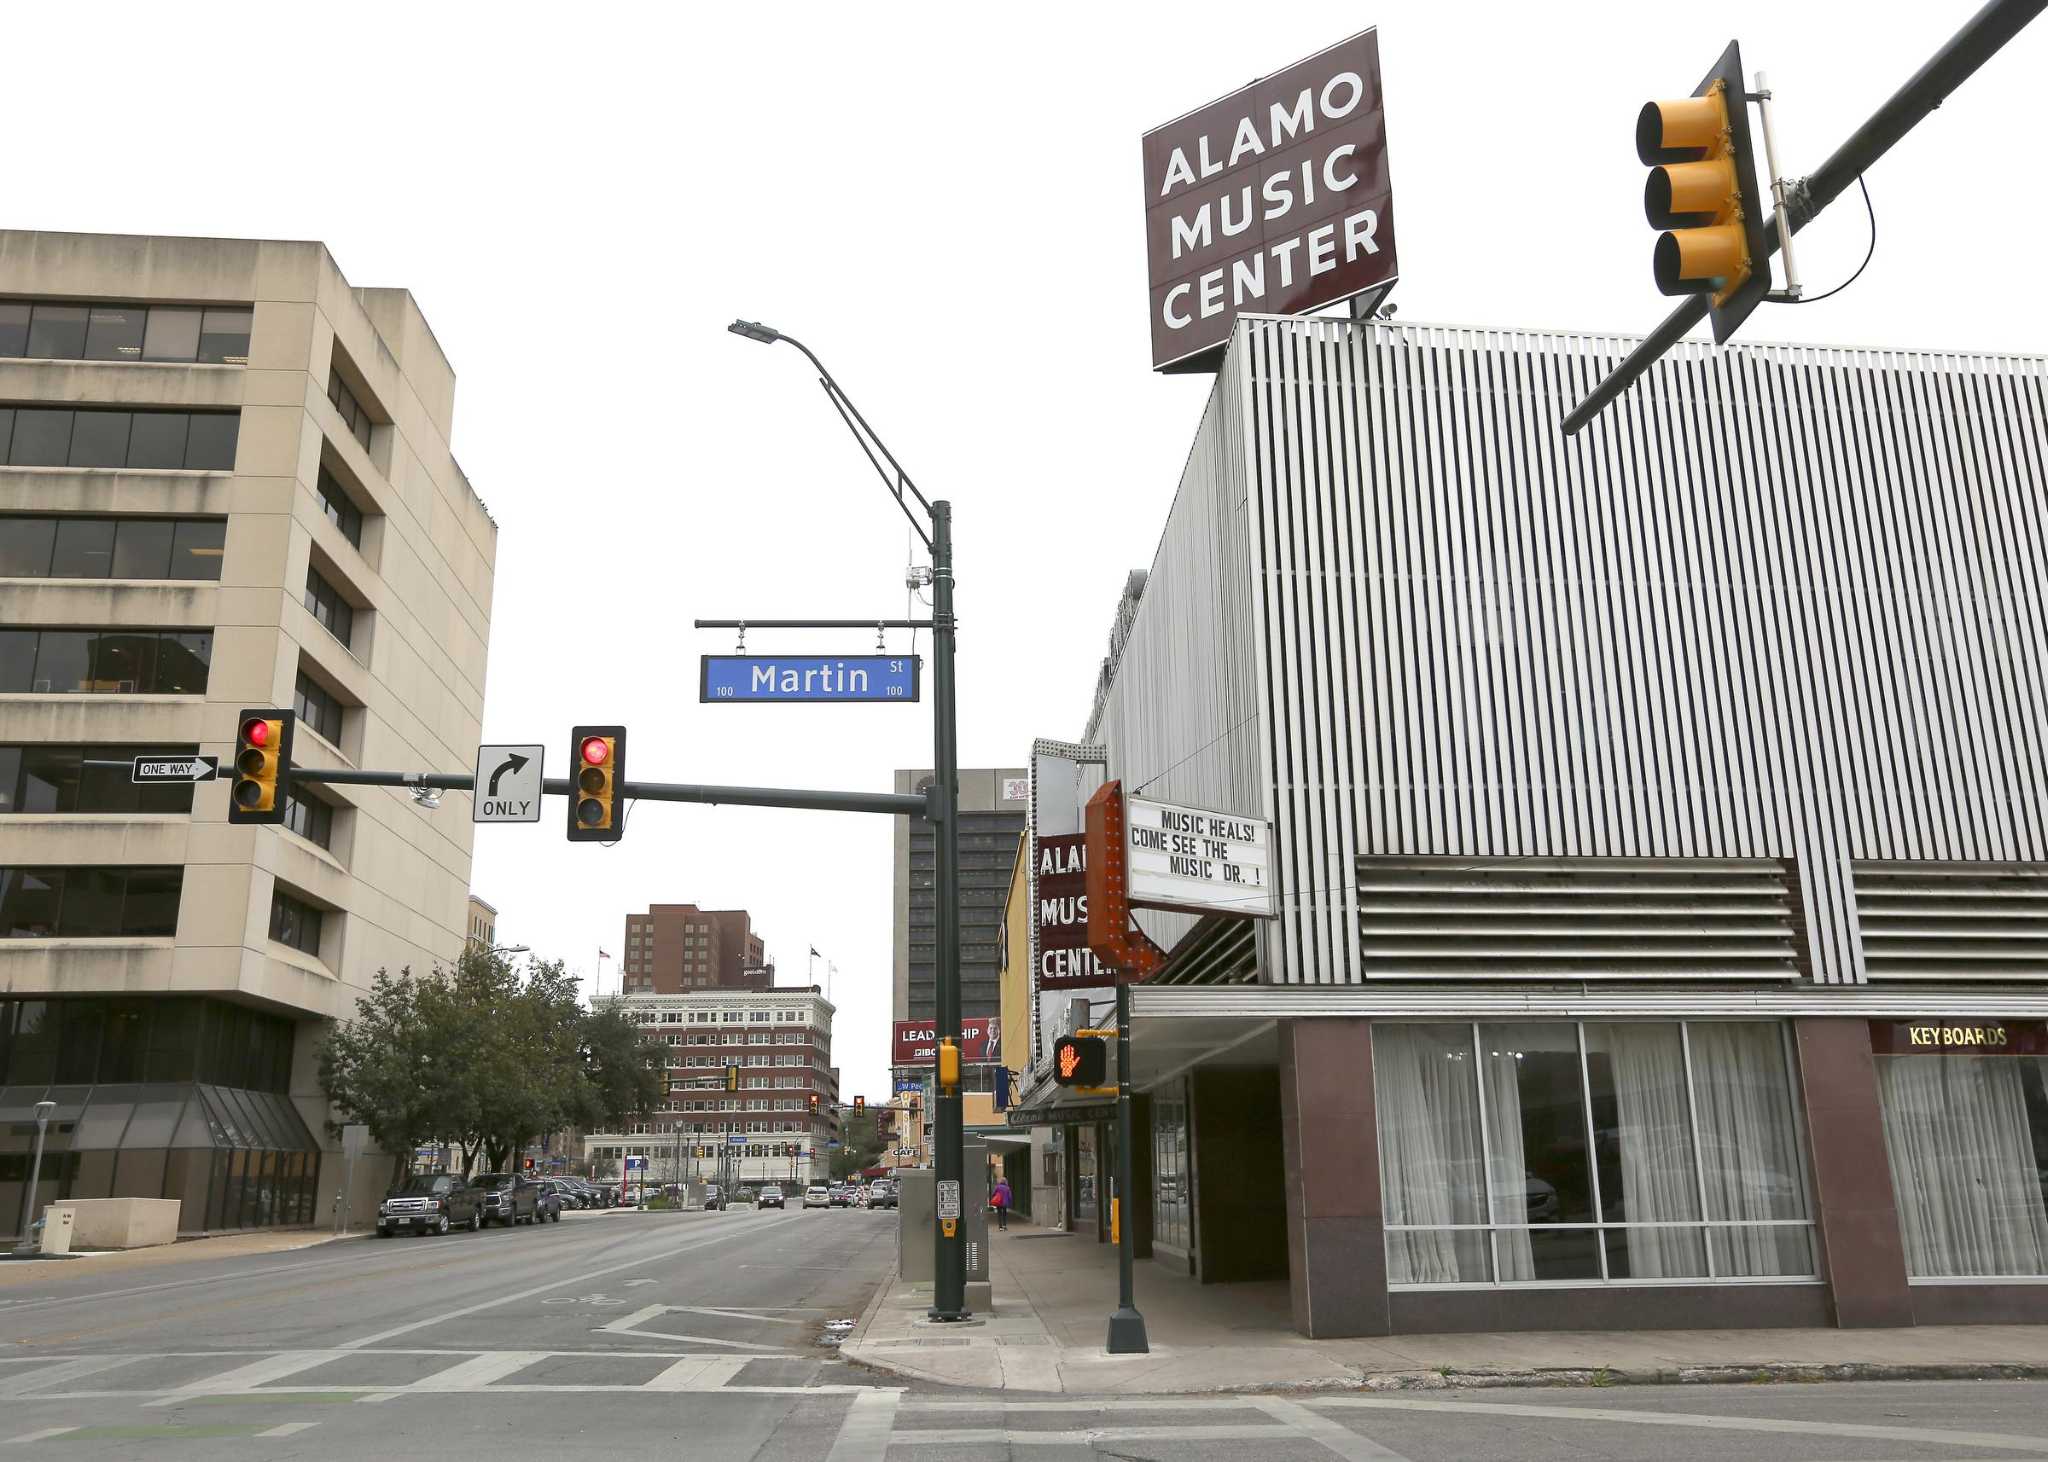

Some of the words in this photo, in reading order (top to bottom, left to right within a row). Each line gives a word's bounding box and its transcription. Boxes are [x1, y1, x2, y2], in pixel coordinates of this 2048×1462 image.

[1161, 72, 1363, 196] ALAMO
[1171, 144, 1358, 260] MUSIC
[1163, 209, 1380, 329] CENTER
[717, 687, 733, 697] 100
[752, 662, 867, 692] Martin
[890, 661, 903, 672] St
[886, 686, 902, 696] 100
[143, 764, 166, 775] ONE
[169, 764, 192, 774] WAY
[483, 801, 530, 815] ONLY
[1161, 810, 1204, 834] MUSIC
[1209, 818, 1255, 842] HEALS!
[1131, 827, 1168, 851] COME
[1172, 834, 1197, 856] SEE
[1202, 838, 1228, 860] THE
[1169, 855, 1213, 880] MUSIC
[1223, 863, 1246, 884] DR.
[1041, 947, 1118, 978] CENTE
[1909, 1027, 2008, 1046] KEYBOARDS
